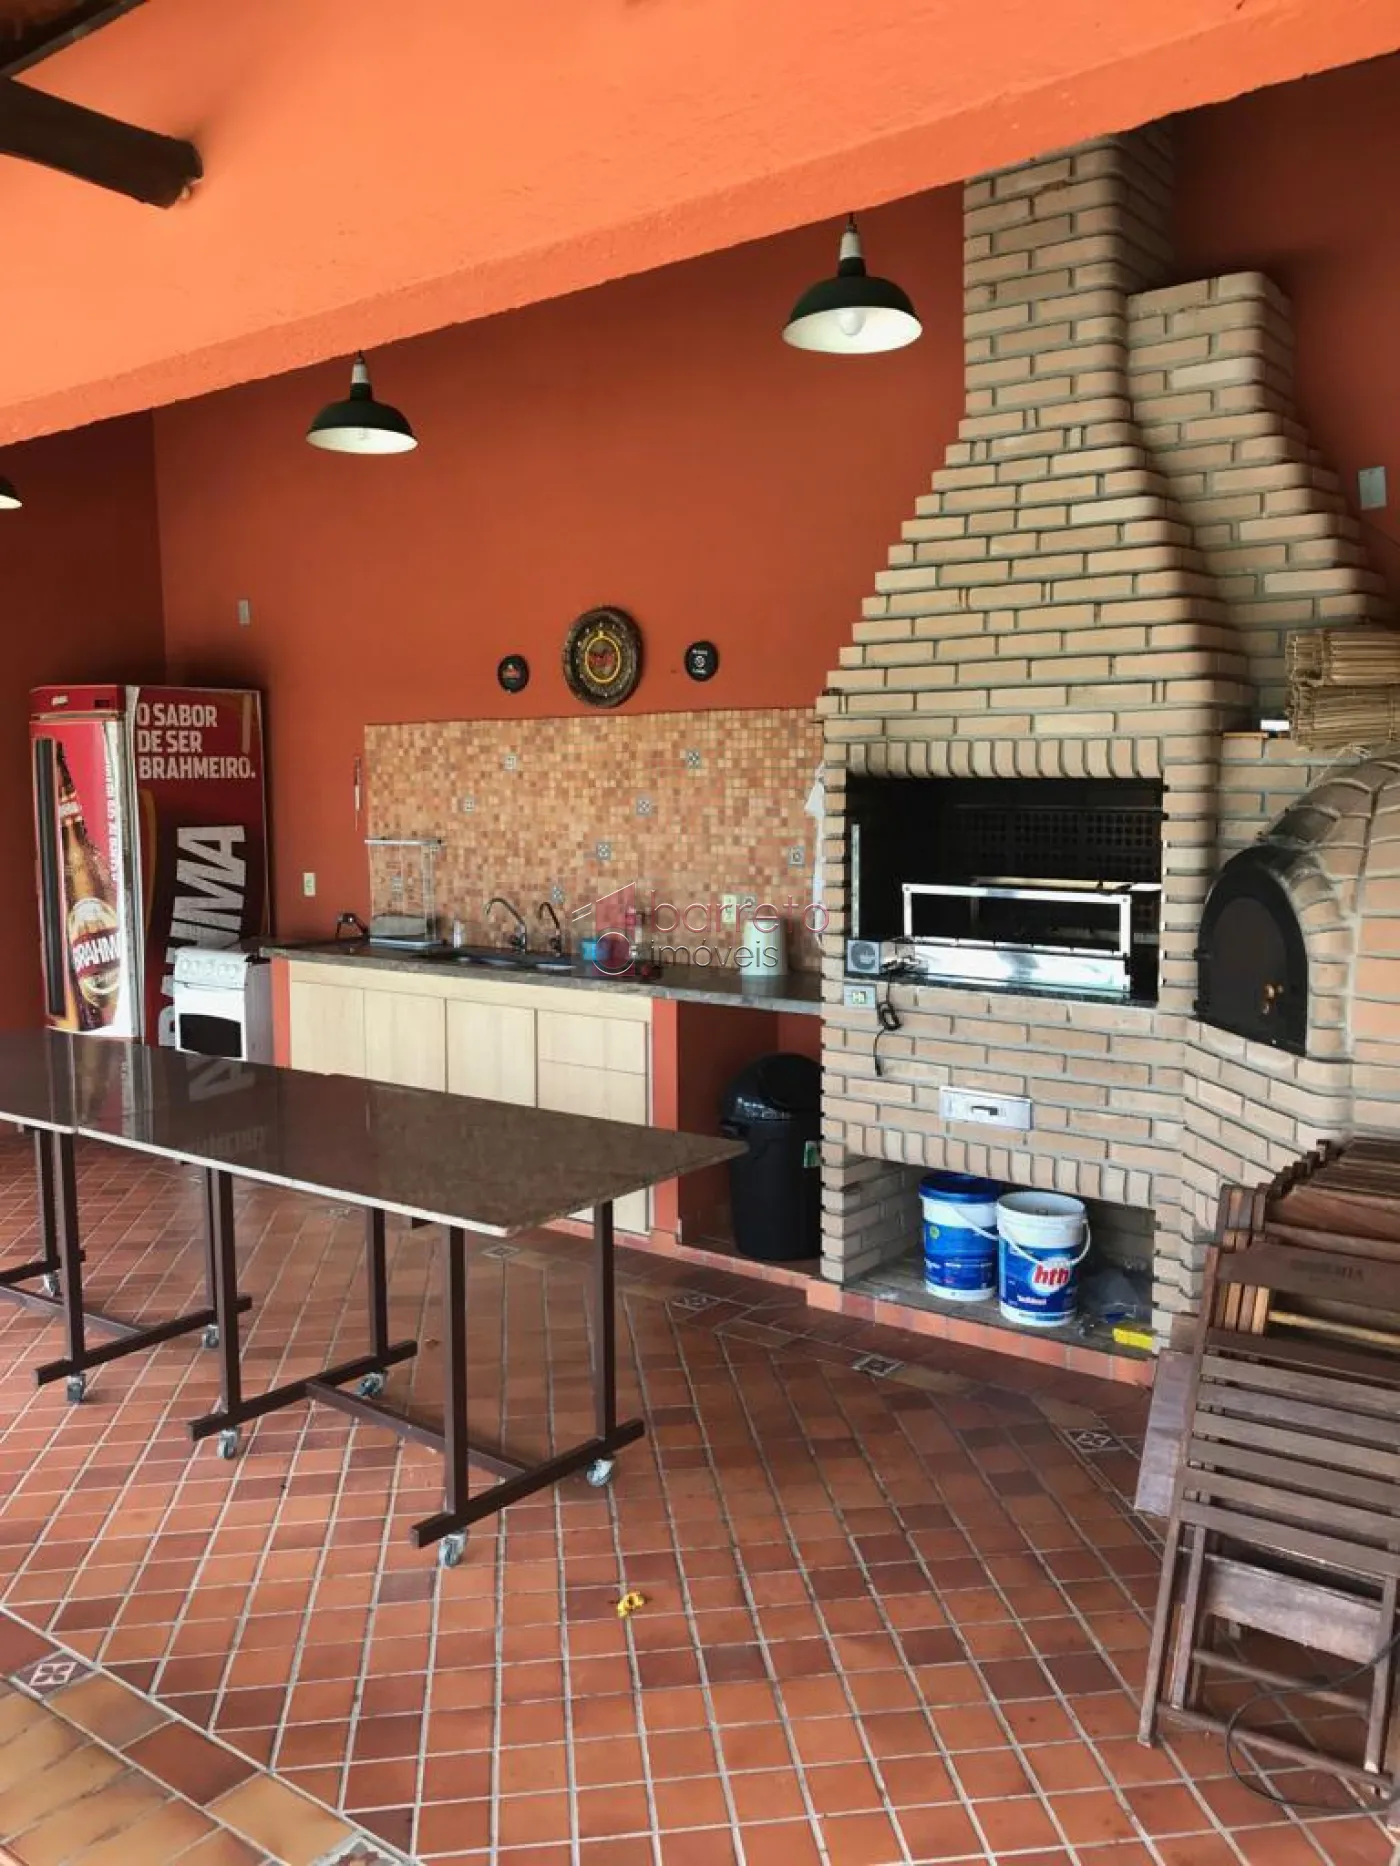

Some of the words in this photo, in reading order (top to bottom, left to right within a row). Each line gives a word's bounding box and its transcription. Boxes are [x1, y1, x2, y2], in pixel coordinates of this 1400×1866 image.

[136, 702, 151, 727] O
[152, 702, 219, 728] SABOR
[137, 730, 163, 754] DE
[165, 730, 203, 754] SER
[138, 756, 256, 779] BRAHMEIRO.
